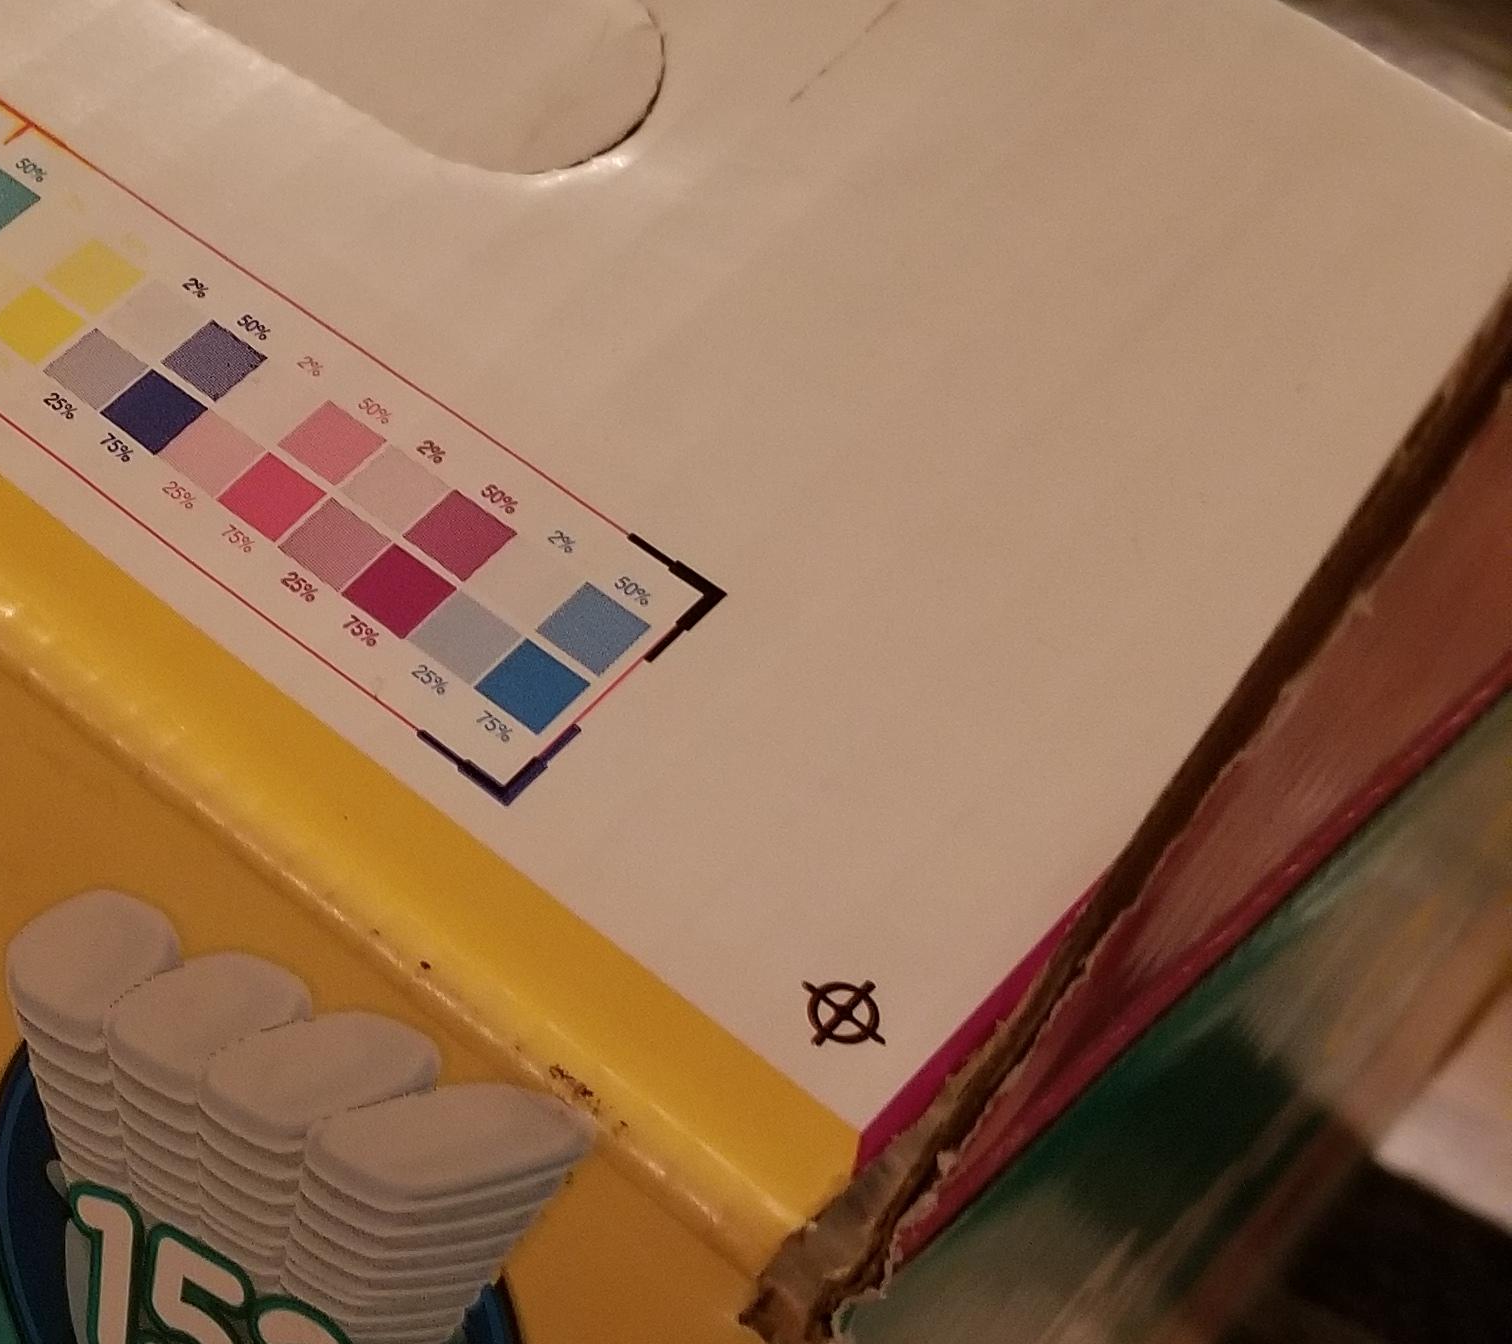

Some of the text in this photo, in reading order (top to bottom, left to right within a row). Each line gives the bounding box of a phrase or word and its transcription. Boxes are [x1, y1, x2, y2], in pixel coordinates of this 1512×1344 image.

[14, 157, 48, 183] 50%
[182, 277, 272, 342] 2% 50%
[296, 354, 391, 425] 2% 50%
[42, 392, 134, 464] 25% 75%
[415, 439, 520, 516] 2% 50%
[161, 480, 253, 554] 25% 75%
[547, 529, 652, 608] 2% 50%
[280, 571, 379, 649] 25% 75%
[410, 663, 512, 744] 25% 75%
